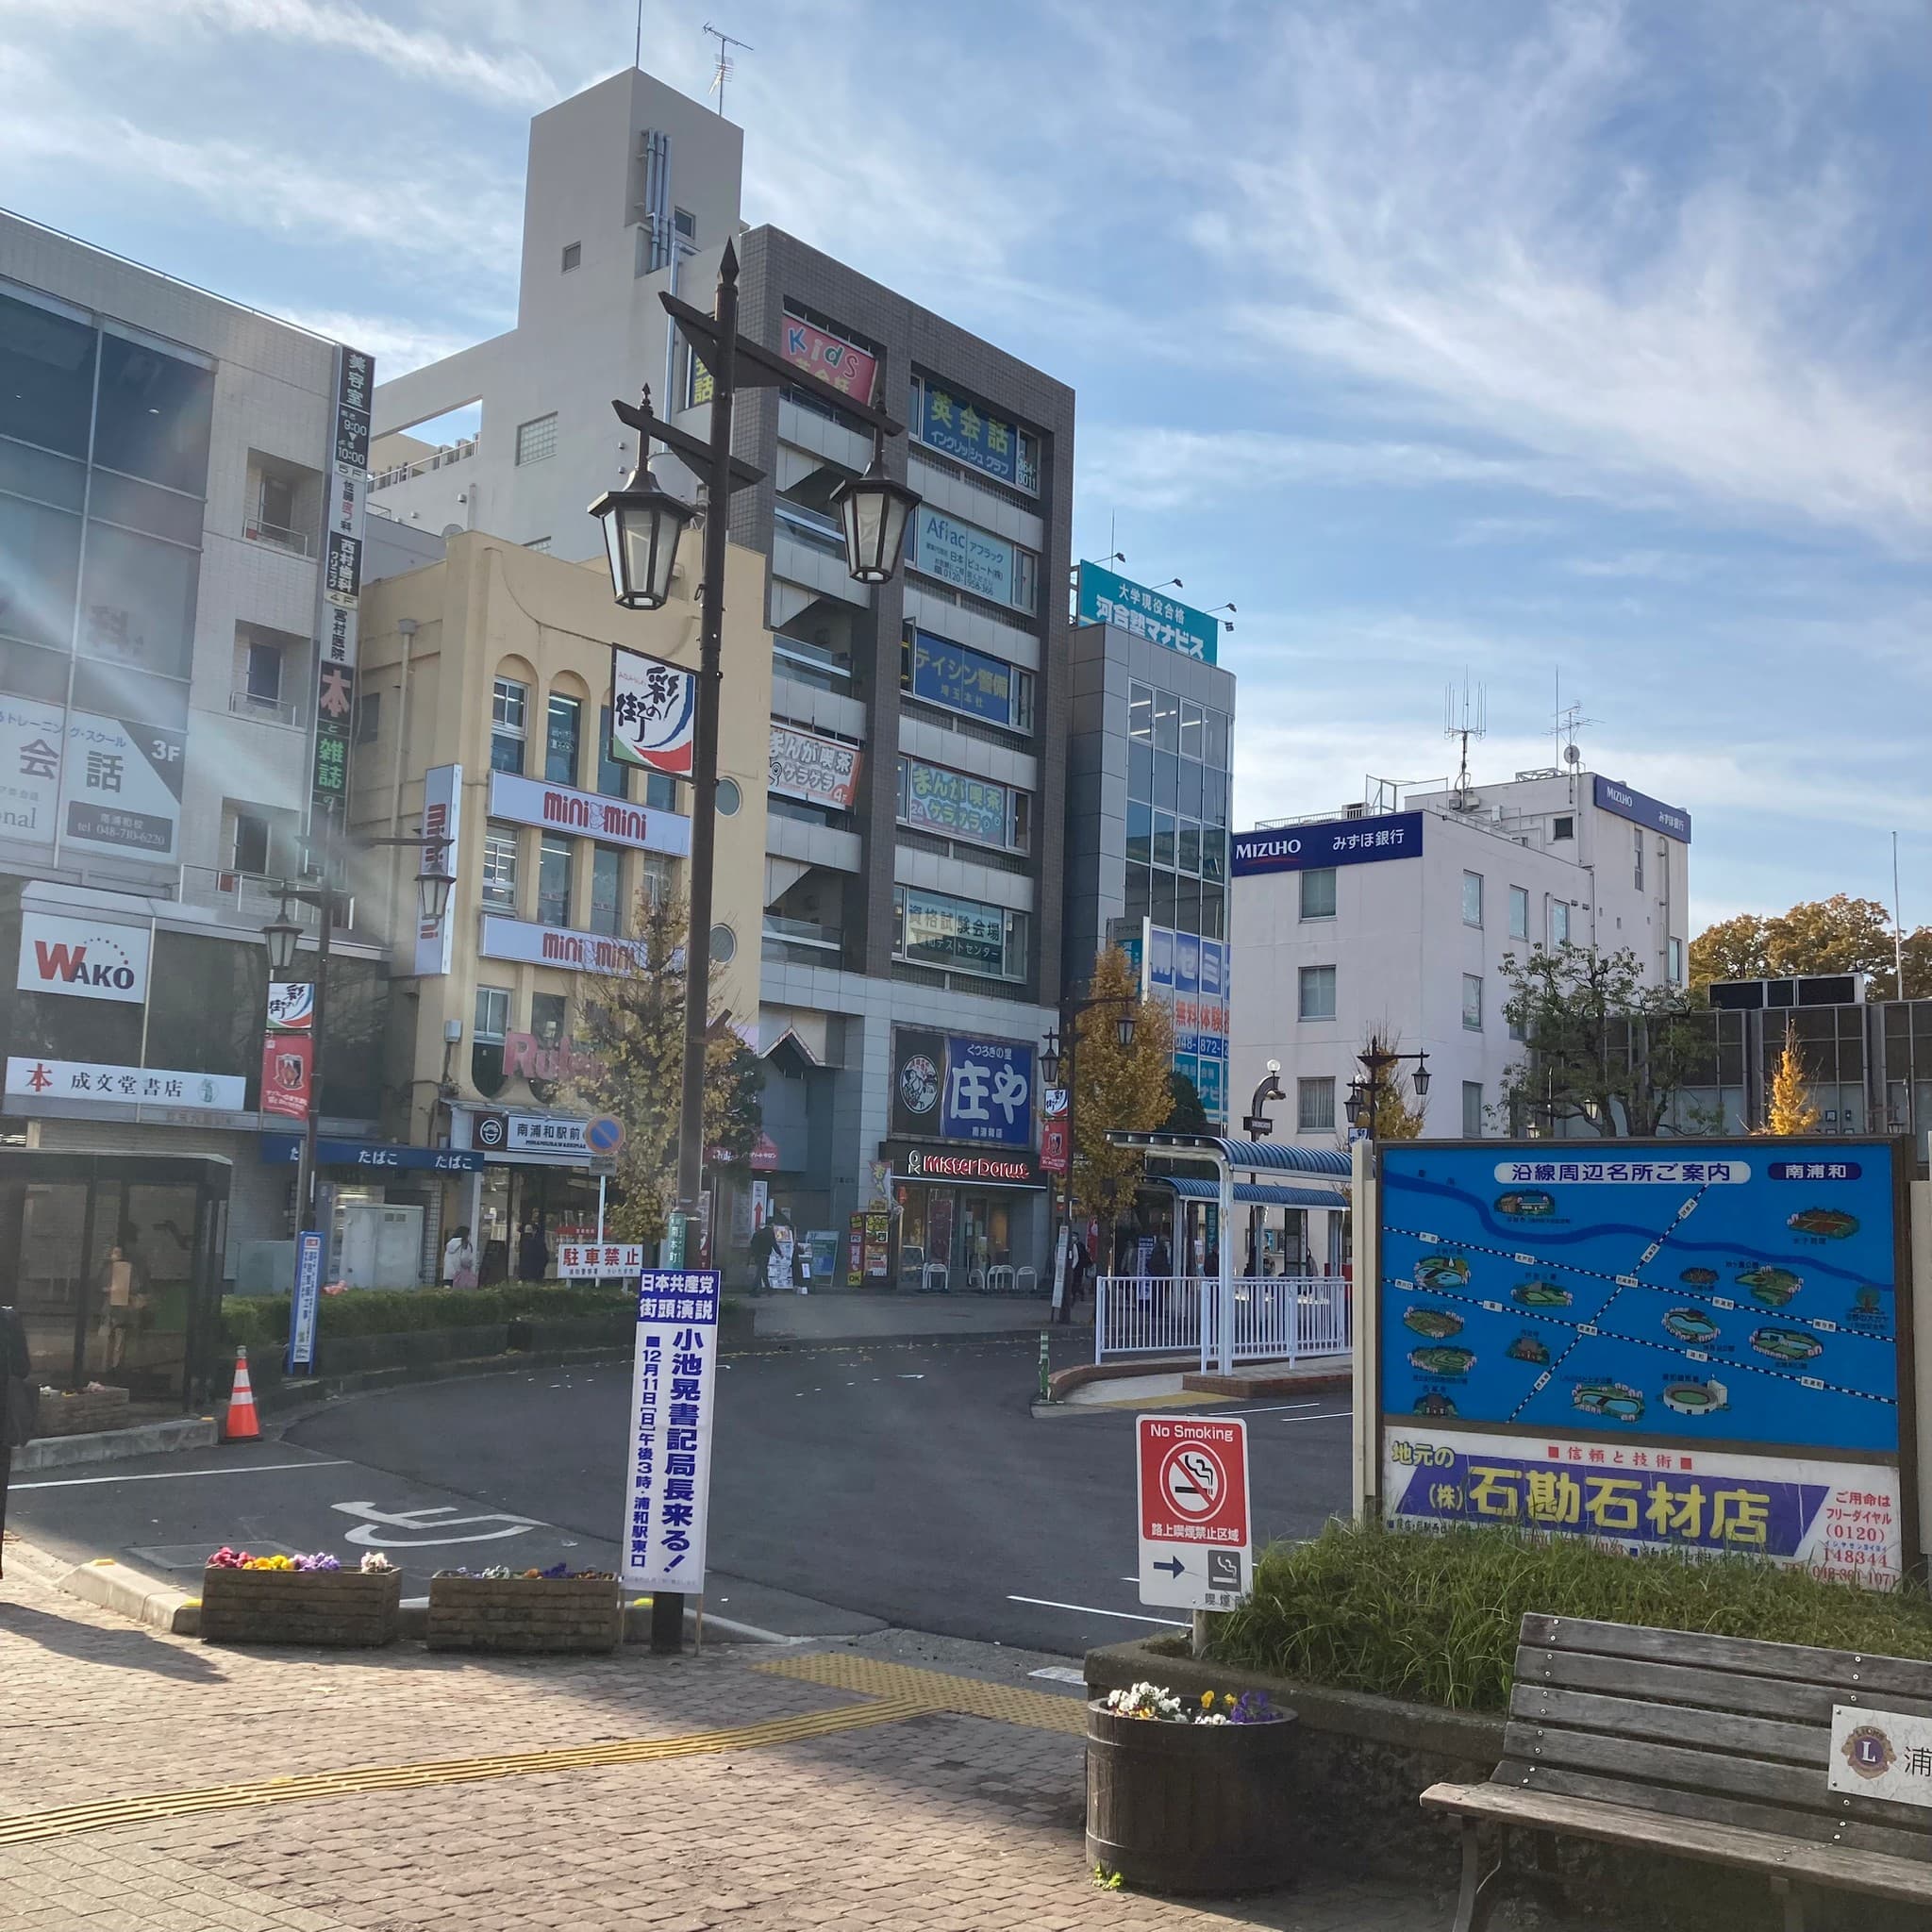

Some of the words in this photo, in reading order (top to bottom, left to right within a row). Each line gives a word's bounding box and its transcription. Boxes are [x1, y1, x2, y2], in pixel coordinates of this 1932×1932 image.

[789, 326, 859, 380] Kids
[346, 354, 366, 408] 美容室
[344, 419, 367, 437] 9:00
[930, 390, 1008, 457] 英会話
[340, 447, 365, 465] 10:00
[1119, 583, 1186, 625] 大学現役合格
[1096, 594, 1205, 660] 河合塾マナビス
[151, 740, 181, 762] 3F
[1236, 839, 1302, 860] MIZUHO
[1332, 828, 1405, 851] みずほ銀行
[908, 905, 1001, 942] 資格試験会場
[34, 940, 135, 990] WAKO
[26, 1062, 53, 1092] 本
[71, 1072, 184, 1098] 成文堂書店
[950, 1059, 1028, 1124] 庄や
[358, 1148, 399, 1166] たばこ
[436, 1154, 473, 1170] たばこ
[1511, 1162, 1731, 1182] 沿線周辺名所ご案内
[1785, 1164, 1846, 1179] 南浦和
[562, 1247, 641, 1267] 駐車禁止
[641, 1274, 715, 1294] 日本共産党
[640, 1297, 714, 1321] 街頭演説
[1150, 1424, 1170, 1438] No
[1174, 1424, 1234, 1442] Smoking
[1391, 1441, 1456, 1469] 地元の
[1568, 1446, 1672, 1469] 信頼と技術
[1428, 1483, 1463, 1510] (株)
[1469, 1466, 1772, 1543] 石勘石材店
[1836, 1491, 1891, 1507] ご用命は
[1826, 1507, 1892, 1525] フリーダイヤル
[1151, 1523, 1240, 1542] 路上喫煙禁止区域
[1826, 1524, 1885, 1543] (0120)
[1824, 1547, 1888, 1568] 148344
[1861, 1740, 1877, 1763] L
[1904, 1746, 1932, 1777] 浦
